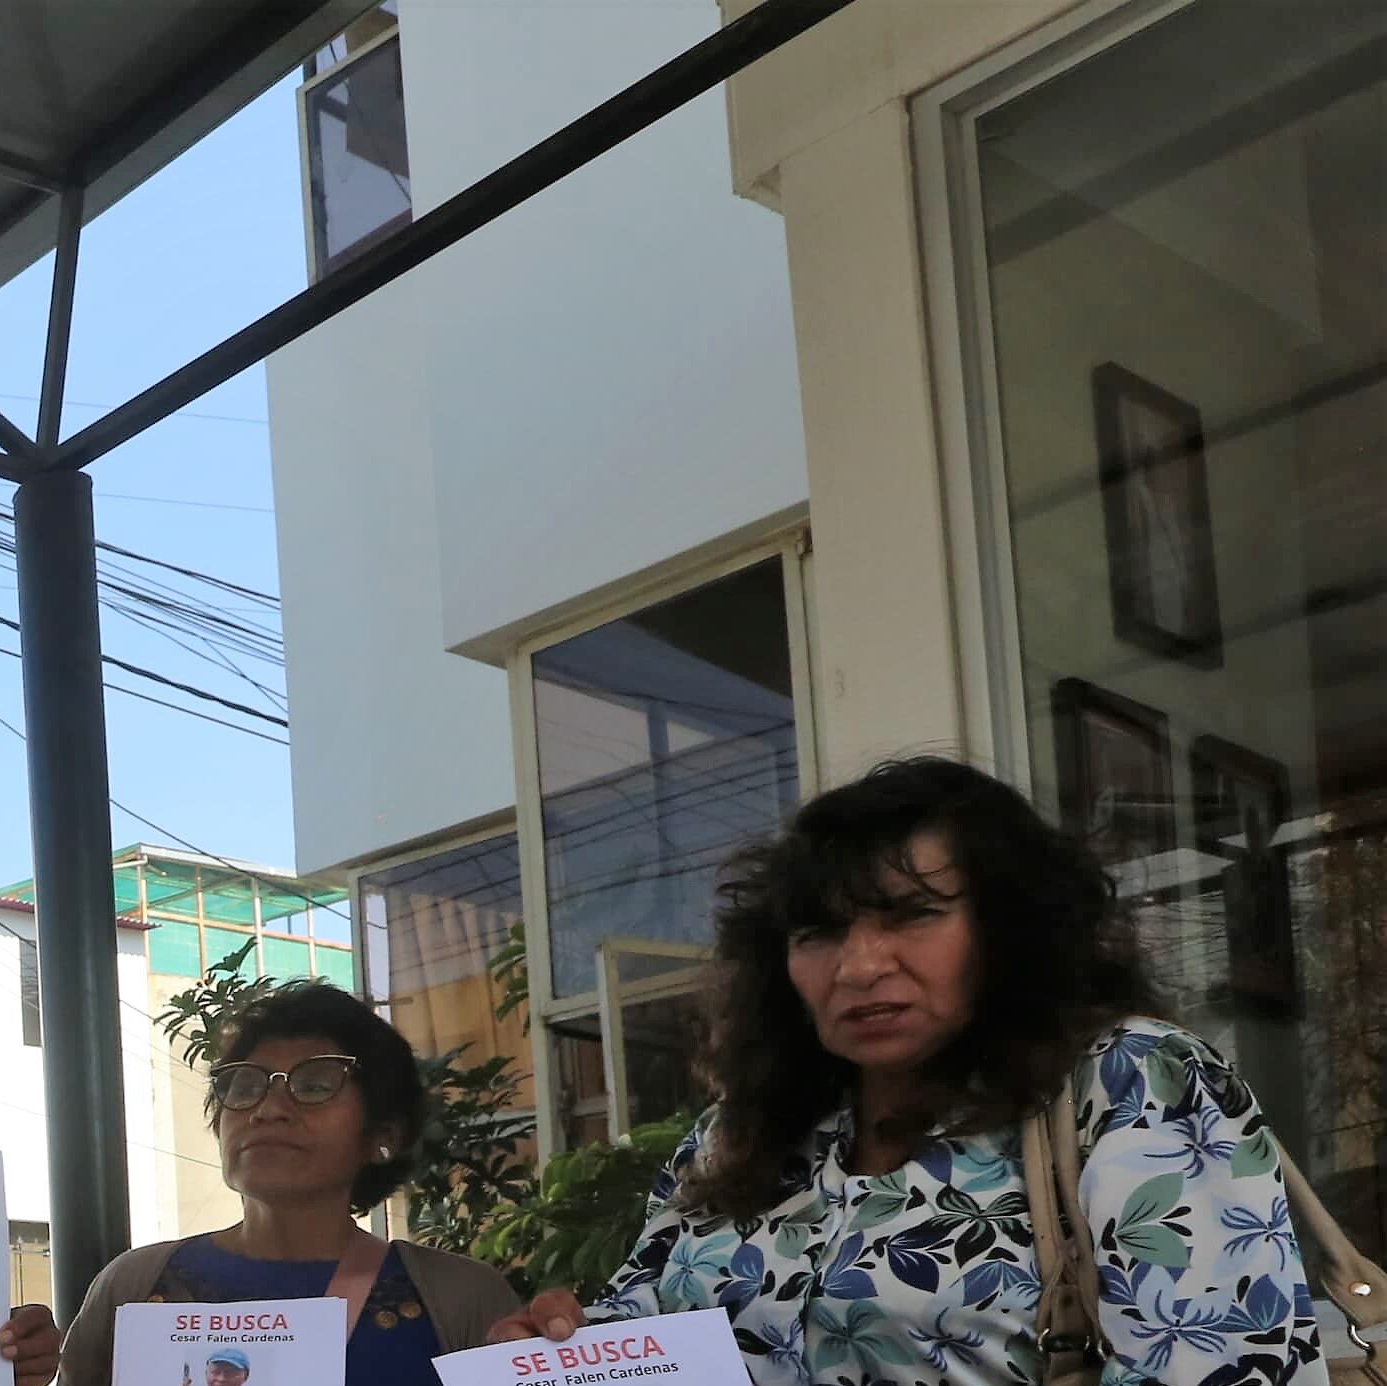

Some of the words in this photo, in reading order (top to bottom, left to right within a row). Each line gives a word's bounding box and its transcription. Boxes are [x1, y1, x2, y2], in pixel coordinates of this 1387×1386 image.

[176, 1315, 202, 1330] SE
[209, 1314, 288, 1331] BUSCA
[170, 1334, 201, 1342] Cesar
[207, 1334, 237, 1343] Falen
[241, 1334, 294, 1342] Cardenas
[511, 1352, 551, 1376] SE
[556, 1335, 665, 1369] BUSCA
[565, 1372, 606, 1386] Falen
[609, 1362, 679, 1380] Cardenas
